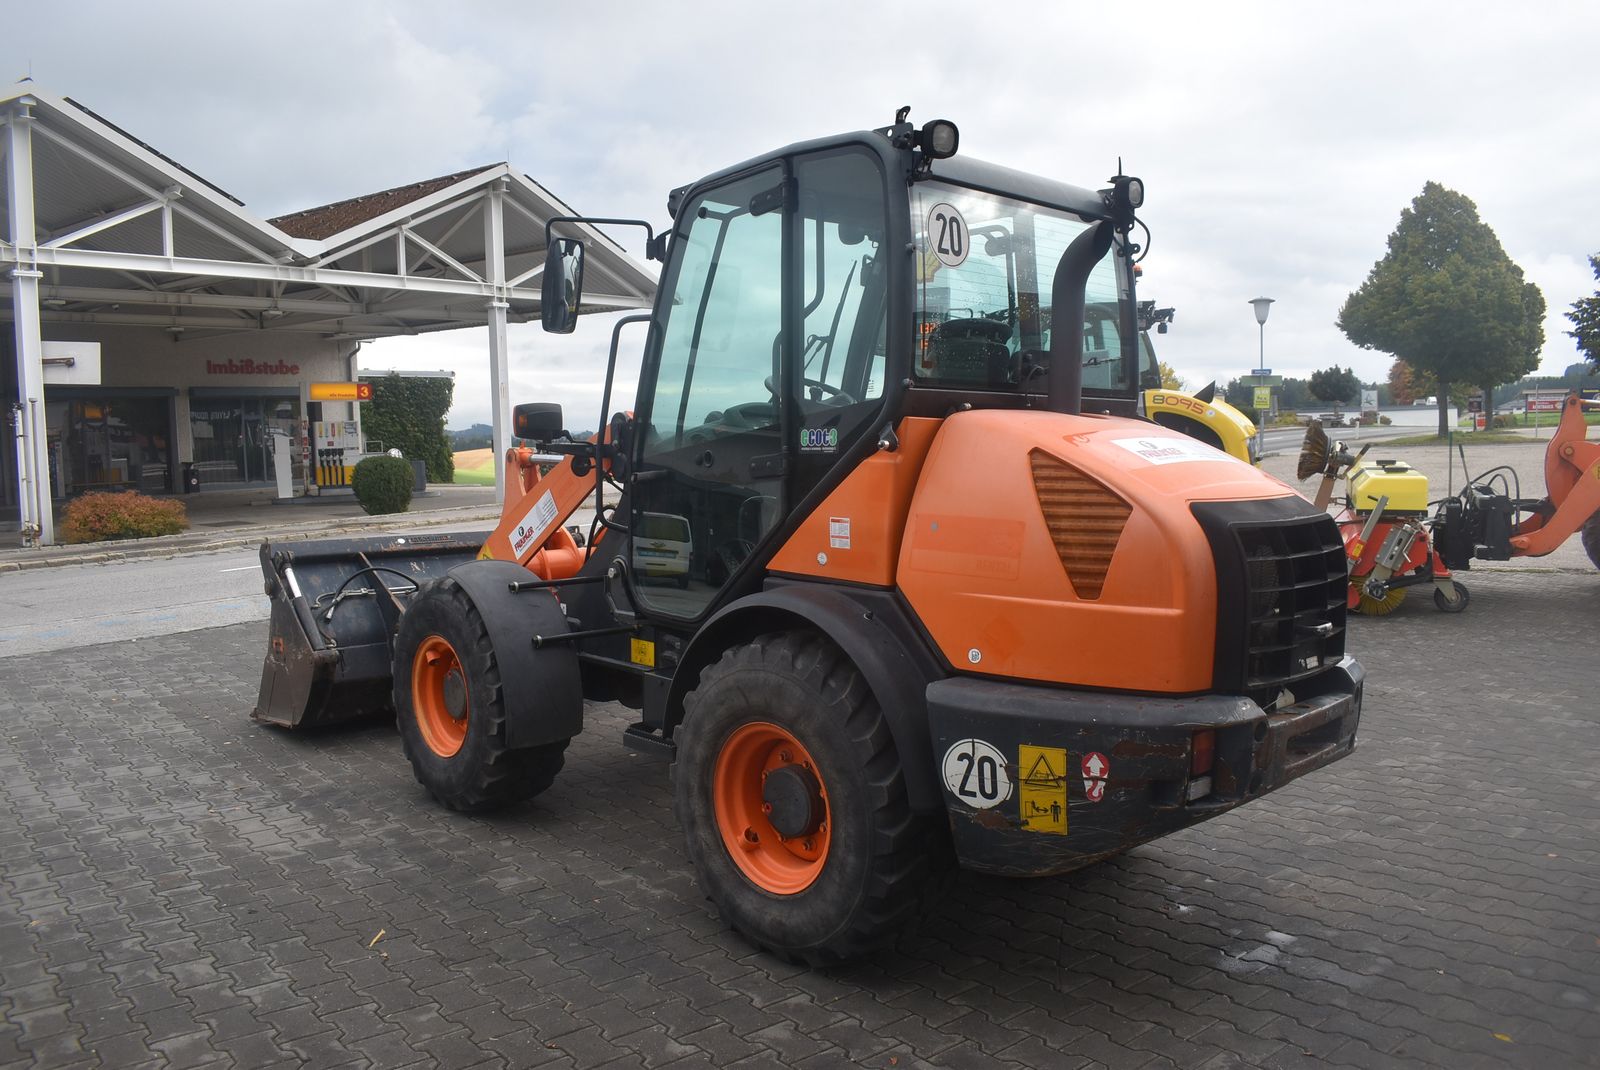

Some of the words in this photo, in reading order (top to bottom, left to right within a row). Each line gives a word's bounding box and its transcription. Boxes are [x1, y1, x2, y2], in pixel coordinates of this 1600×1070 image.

[935, 212, 963, 257] 20
[206, 358, 300, 375] Imbißstube
[360, 386, 369, 398] 3
[1152, 394, 1205, 415] 8095
[957, 752, 998, 800] 20
